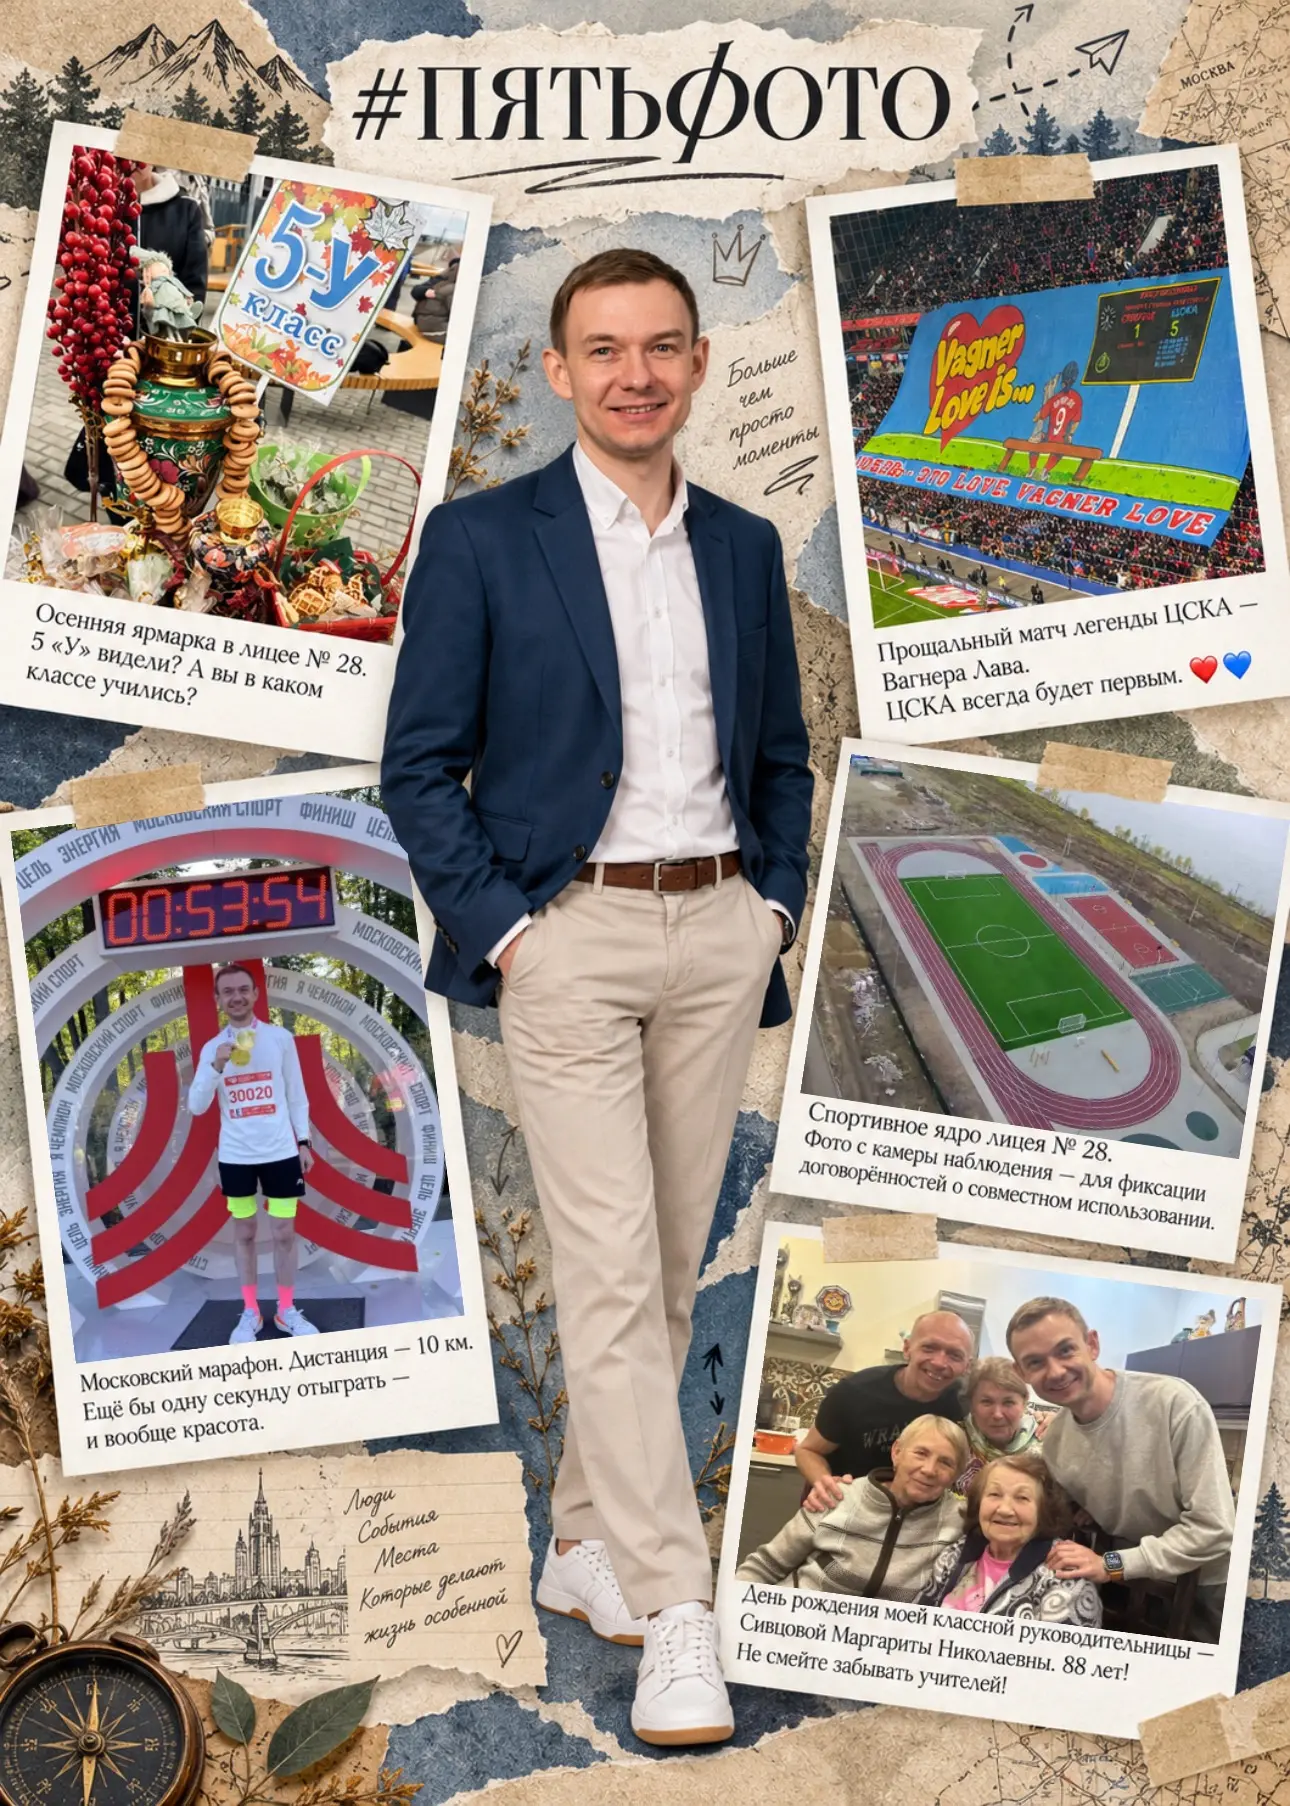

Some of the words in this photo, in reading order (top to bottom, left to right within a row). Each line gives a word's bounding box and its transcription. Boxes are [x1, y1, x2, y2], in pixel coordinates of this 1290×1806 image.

[1180, 61, 1236, 89] МОСКВА
[241, 290, 342, 358] класс
[1133, 323, 1141, 339] 1
[1169, 320, 1180, 337] 5
[727, 350, 798, 388] Больше
[935, 322, 1024, 387] Vagner
[739, 387, 773, 408] чем
[923, 381, 989, 435] Love
[729, 406, 795, 448] просто
[1053, 406, 1067, 436] 9
[732, 426, 820, 470] моменты
[953, 473, 1007, 498] LOVE
[1016, 483, 1119, 518] VAGNER
[1124, 500, 1215, 536] LOVE
[16, 859, 52, 890] ЦЕЛЬ
[57, 824, 121, 864] ЭНЕРГИЯ
[300, 801, 357, 829] ФИНИШ
[107, 873, 329, 945] 00:53:54
[48, 953, 84, 988] СПОРТ
[150, 984, 185, 1009] ФИНИ
[307, 985, 356, 1016] ЧЕМПИОН
[113, 1005, 145, 1035] СПОРТ
[65, 1029, 116, 1094] МОСКОВСКИЙ
[229, 1085, 273, 1104] 30020
[51, 1100, 73, 1150] ЧЕМПИОН
[420, 1124, 438, 1166] ФИНИШ
[53, 1170, 74, 1218] ЭНЕРГИЯ
[417, 1174, 436, 1202] ЦЕЛЬ
[66, 1222, 89, 1250] ЦЕЛЬ
[343, 1488, 396, 1517] Люди
[358, 1509, 439, 1544] События
[374, 1542, 440, 1574] Места
[359, 1580, 432, 1612] Которые
[436, 1559, 506, 1601] делают
[364, 1618, 416, 1649] жизнь
[424, 1588, 509, 1627] особенной
